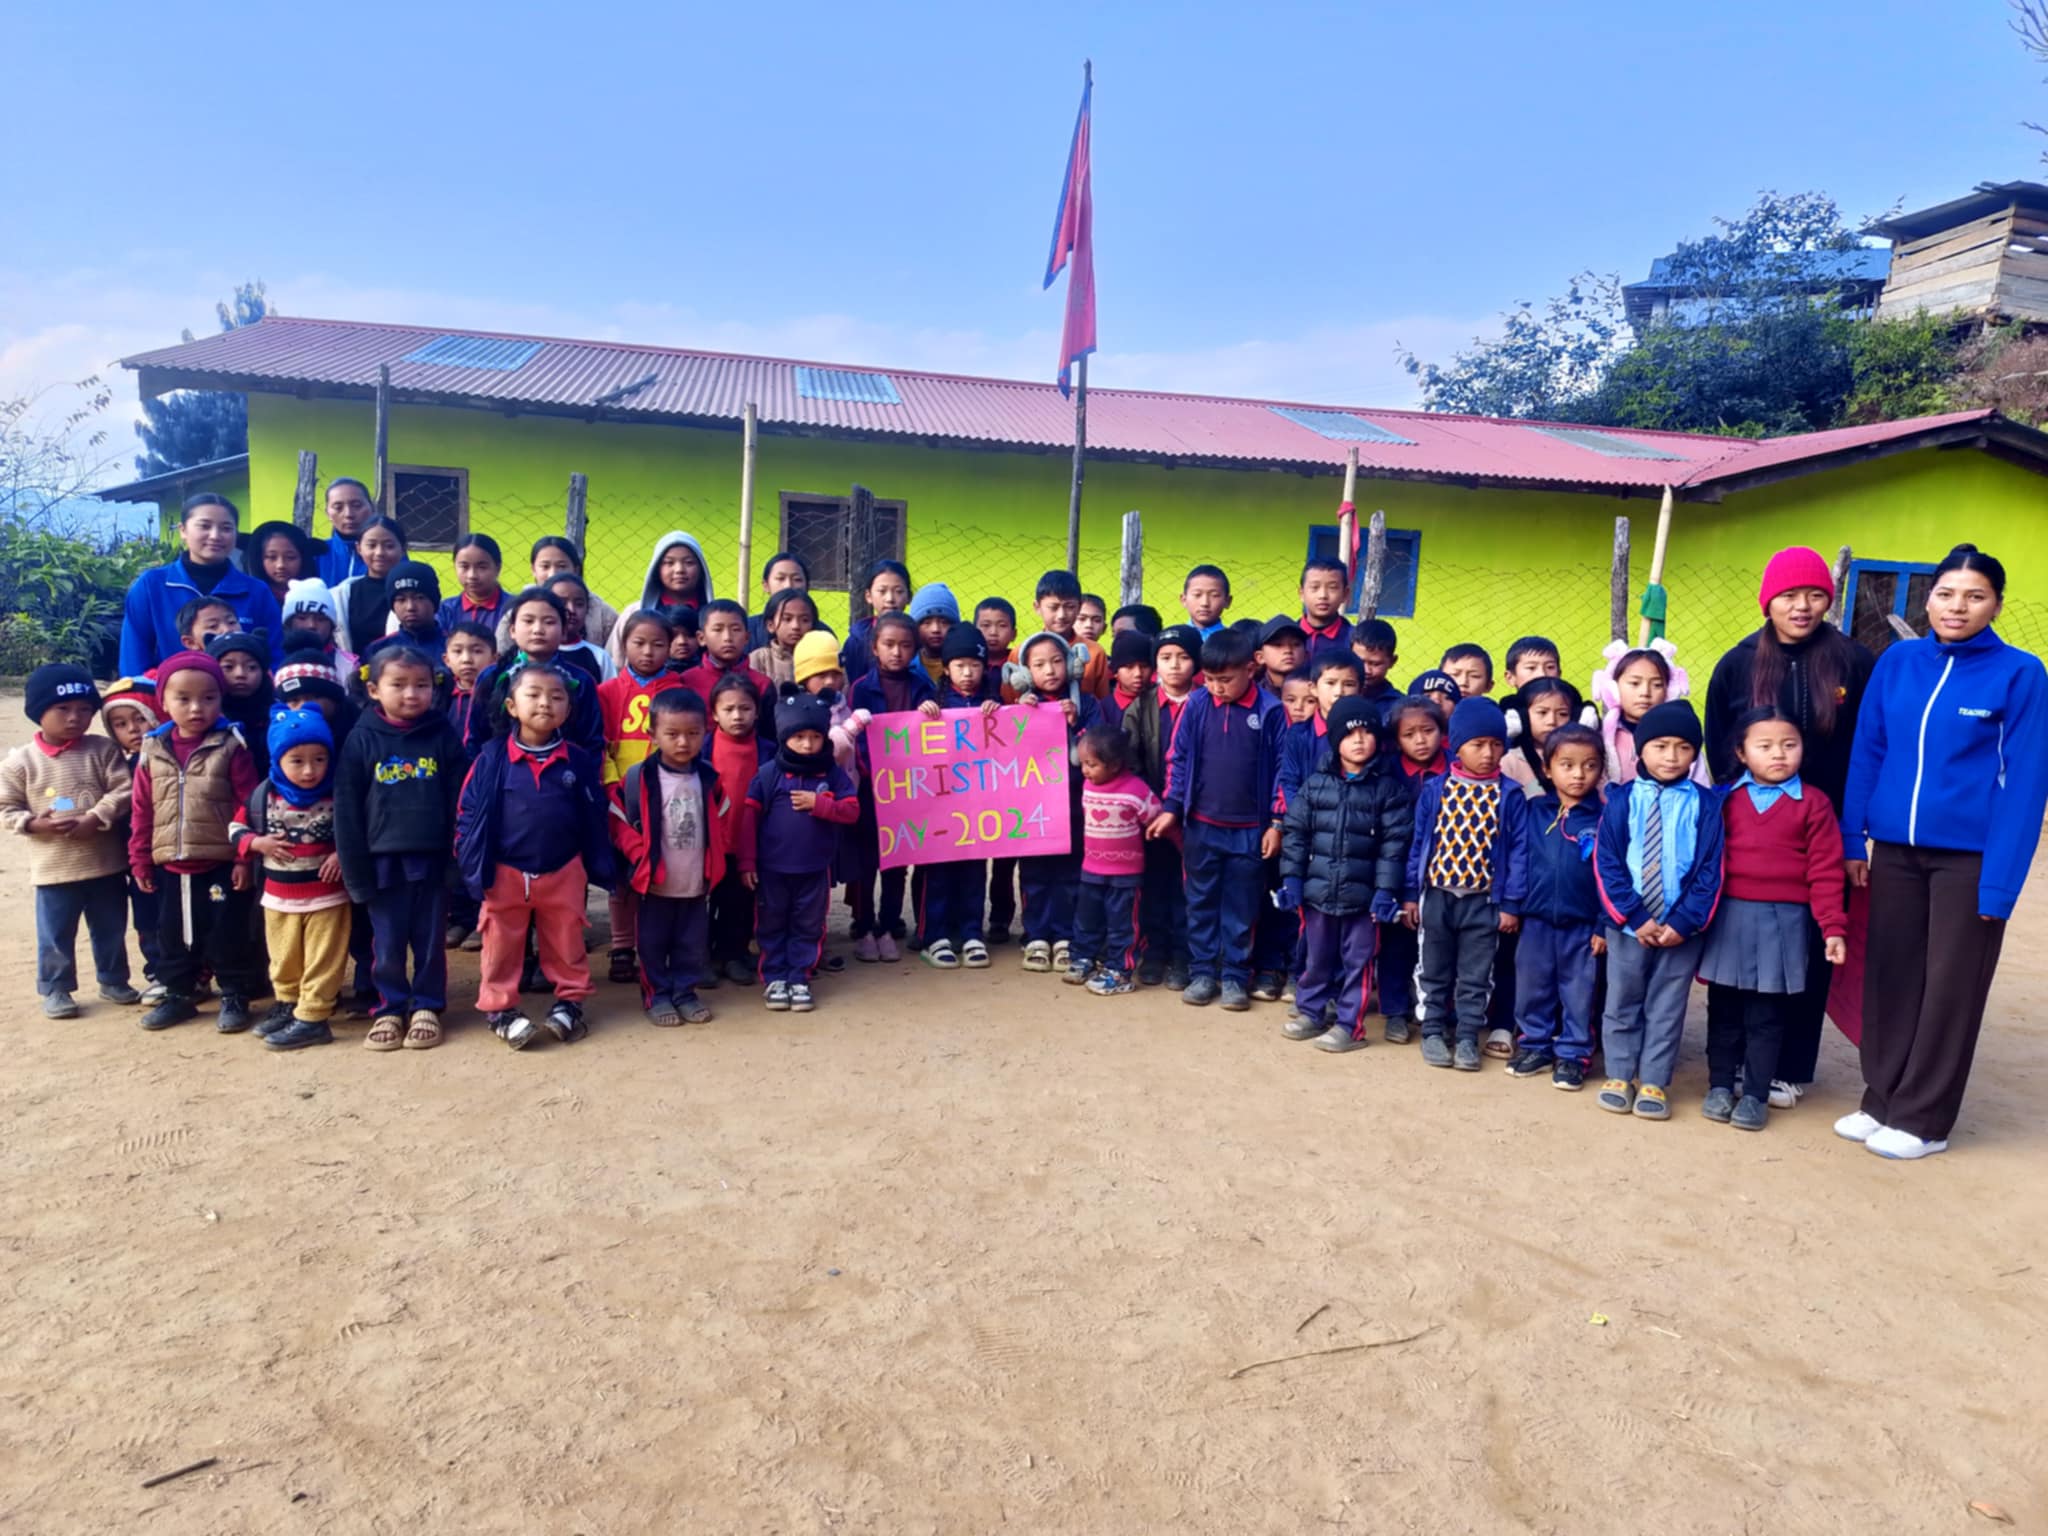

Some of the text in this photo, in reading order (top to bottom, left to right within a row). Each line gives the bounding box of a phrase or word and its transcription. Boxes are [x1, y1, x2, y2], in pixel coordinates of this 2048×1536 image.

[56, 682, 92, 696] OBEY
[1423, 677, 1455, 693] UFC
[883, 713, 1030, 756] MERRY
[873, 747, 1064, 804] CHRISTMAS
